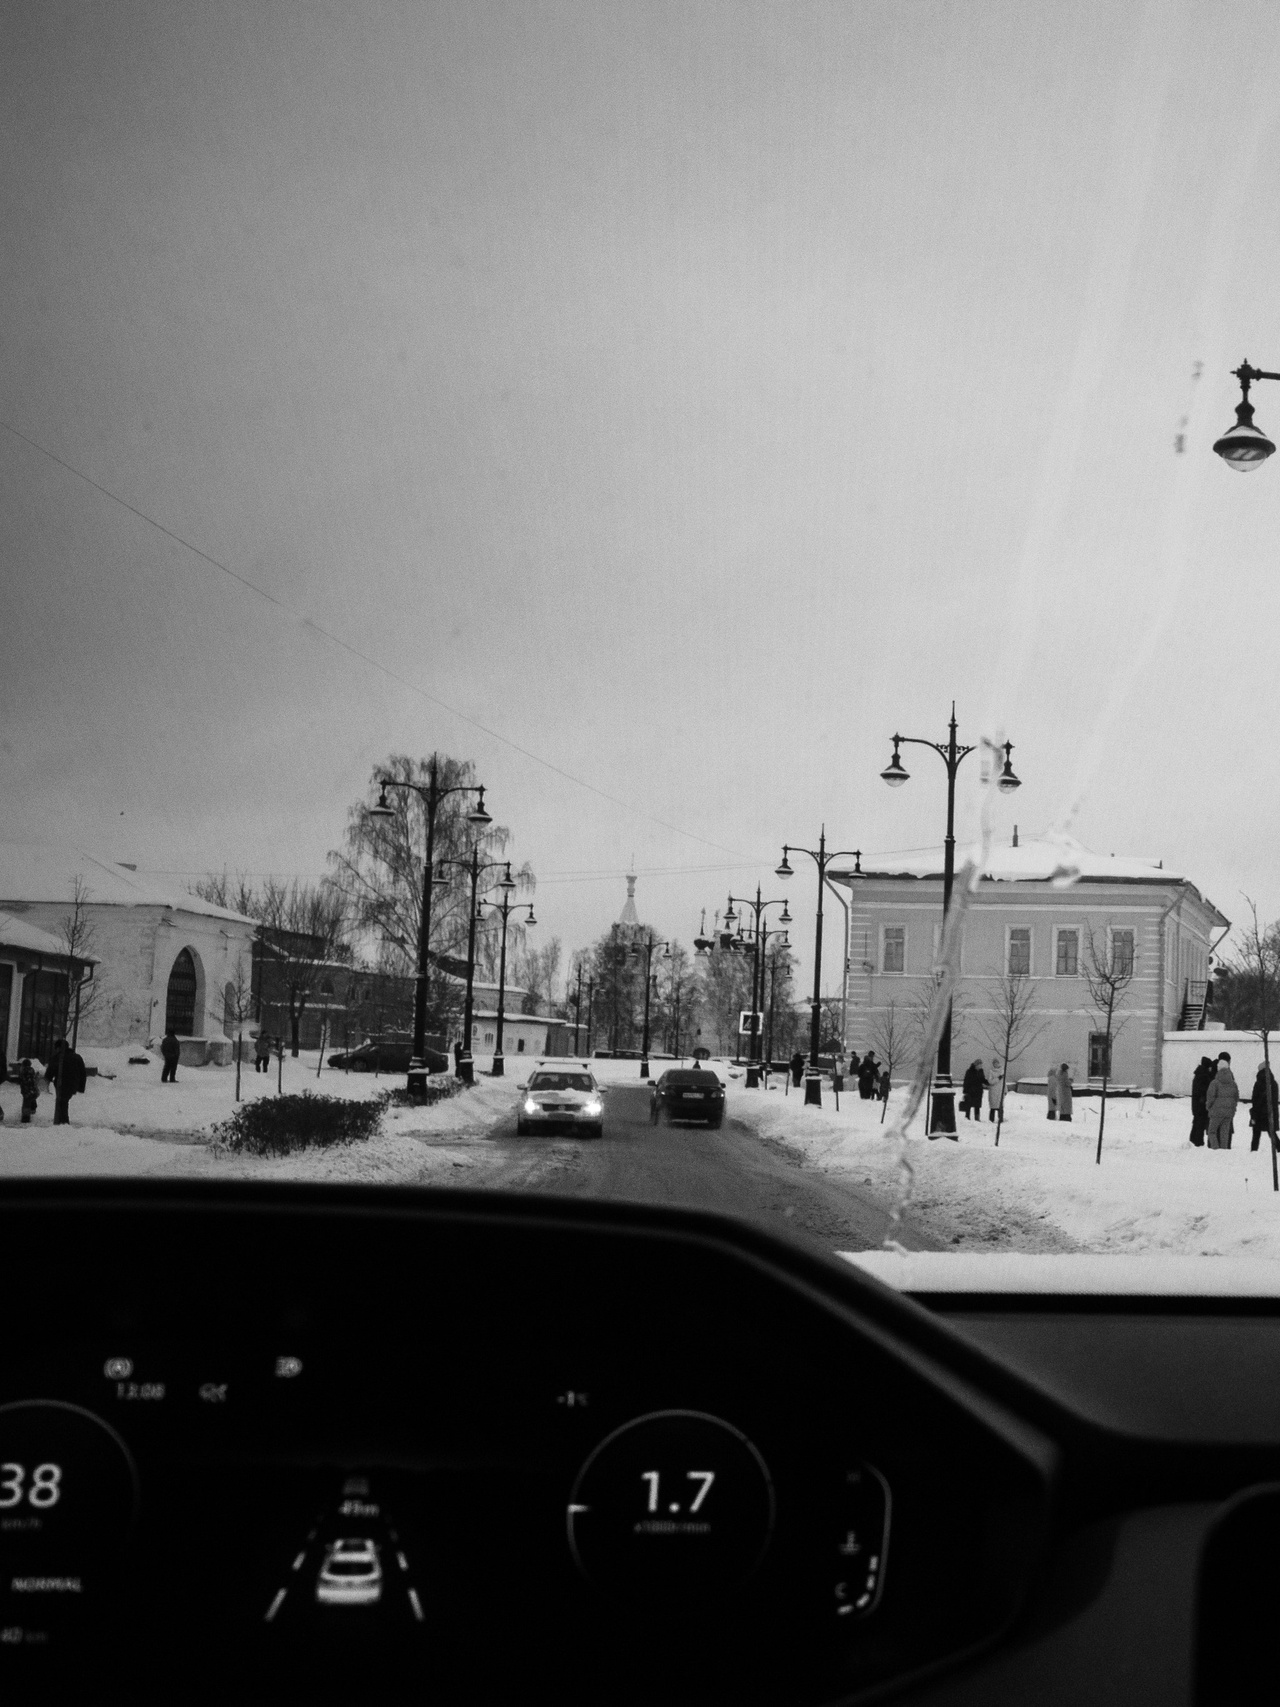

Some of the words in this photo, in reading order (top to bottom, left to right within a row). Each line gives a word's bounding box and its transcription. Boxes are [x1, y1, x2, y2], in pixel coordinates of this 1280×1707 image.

[0, 1462, 62, 1509] 38
[641, 1470, 716, 1513] 1.7
[11, 1577, 82, 1592] NORMAL
